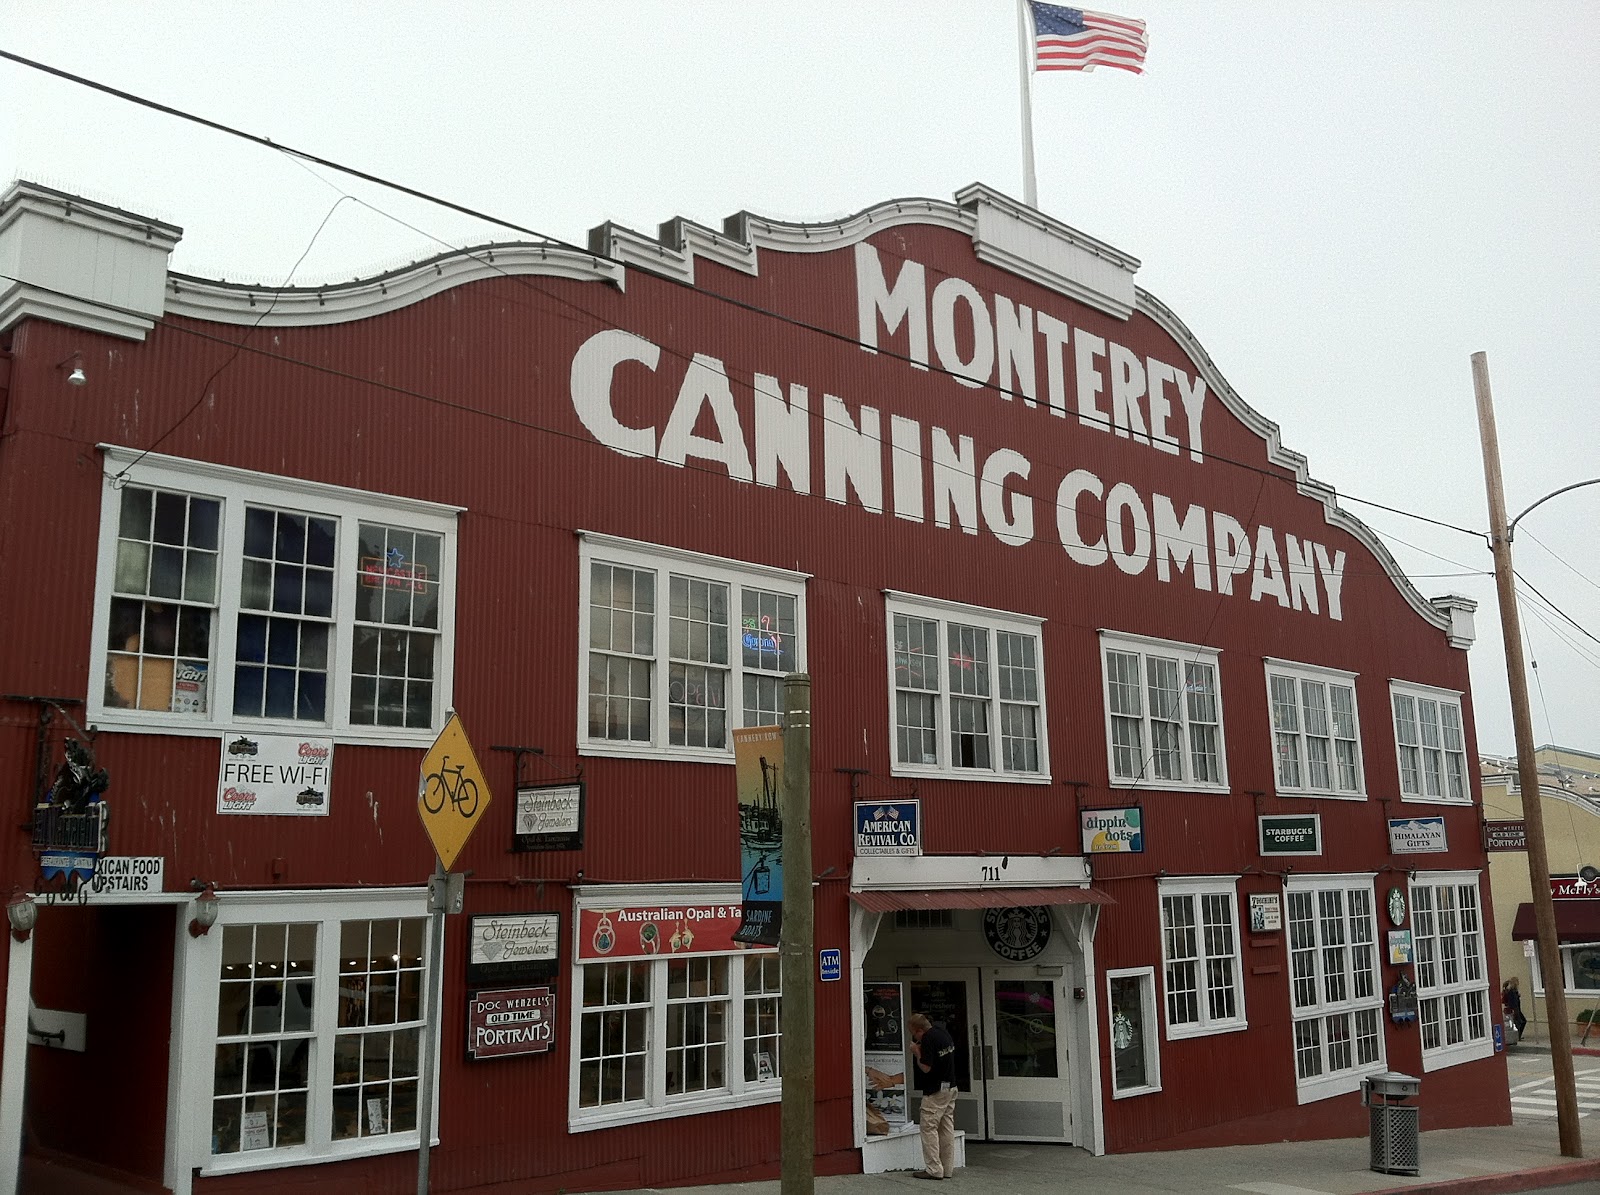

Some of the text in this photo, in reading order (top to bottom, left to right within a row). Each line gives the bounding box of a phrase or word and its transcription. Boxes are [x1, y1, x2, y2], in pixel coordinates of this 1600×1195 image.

[854, 241, 1207, 464] MONTEREY
[570, 328, 1346, 622] CANNING COMPANY
[365, 564, 423, 579] NEWCASTE
[298, 742, 329, 758] Coors
[298, 756, 327, 765] LIGHT
[224, 763, 329, 785] FREE WI-FI
[223, 787, 257, 802] Coors
[523, 790, 574, 813] Steinbeck
[222, 801, 254, 811] LIGHT
[537, 812, 573, 832] Jewelers
[862, 820, 911, 833] AMERICAN
[858, 832, 917, 846] REVIVAL CO.
[1105, 829, 1133, 841] dots
[1265, 827, 1314, 836] STARBUCKS
[1274, 834, 1305, 843] COFFEE
[1394, 831, 1441, 841] HIMALAYAN
[1406, 839, 1431, 848] GIFTS
[1487, 837, 1526, 848] PORTRAIT
[97, 859, 160, 875] XICAN FOOD
[981, 866, 1000, 881] 711
[92, 875, 149, 891] UPSTAIRS
[1558, 883, 1600, 896] McFly's
[617, 907, 743, 922] Australian Opal & Ta
[746, 909, 773, 923] SARDINE
[482, 919, 550, 942] Steinbeck
[739, 924, 763, 939] BOATS
[502, 940, 550, 960] Jewelers
[994, 941, 1042, 960] COFFEE
[822, 956, 839, 966] ATM
[478, 996, 550, 1014] DOC WENZEL'S
[491, 1010, 535, 1023] OLD TIME
[476, 1020, 550, 1048] PORTRAITS
